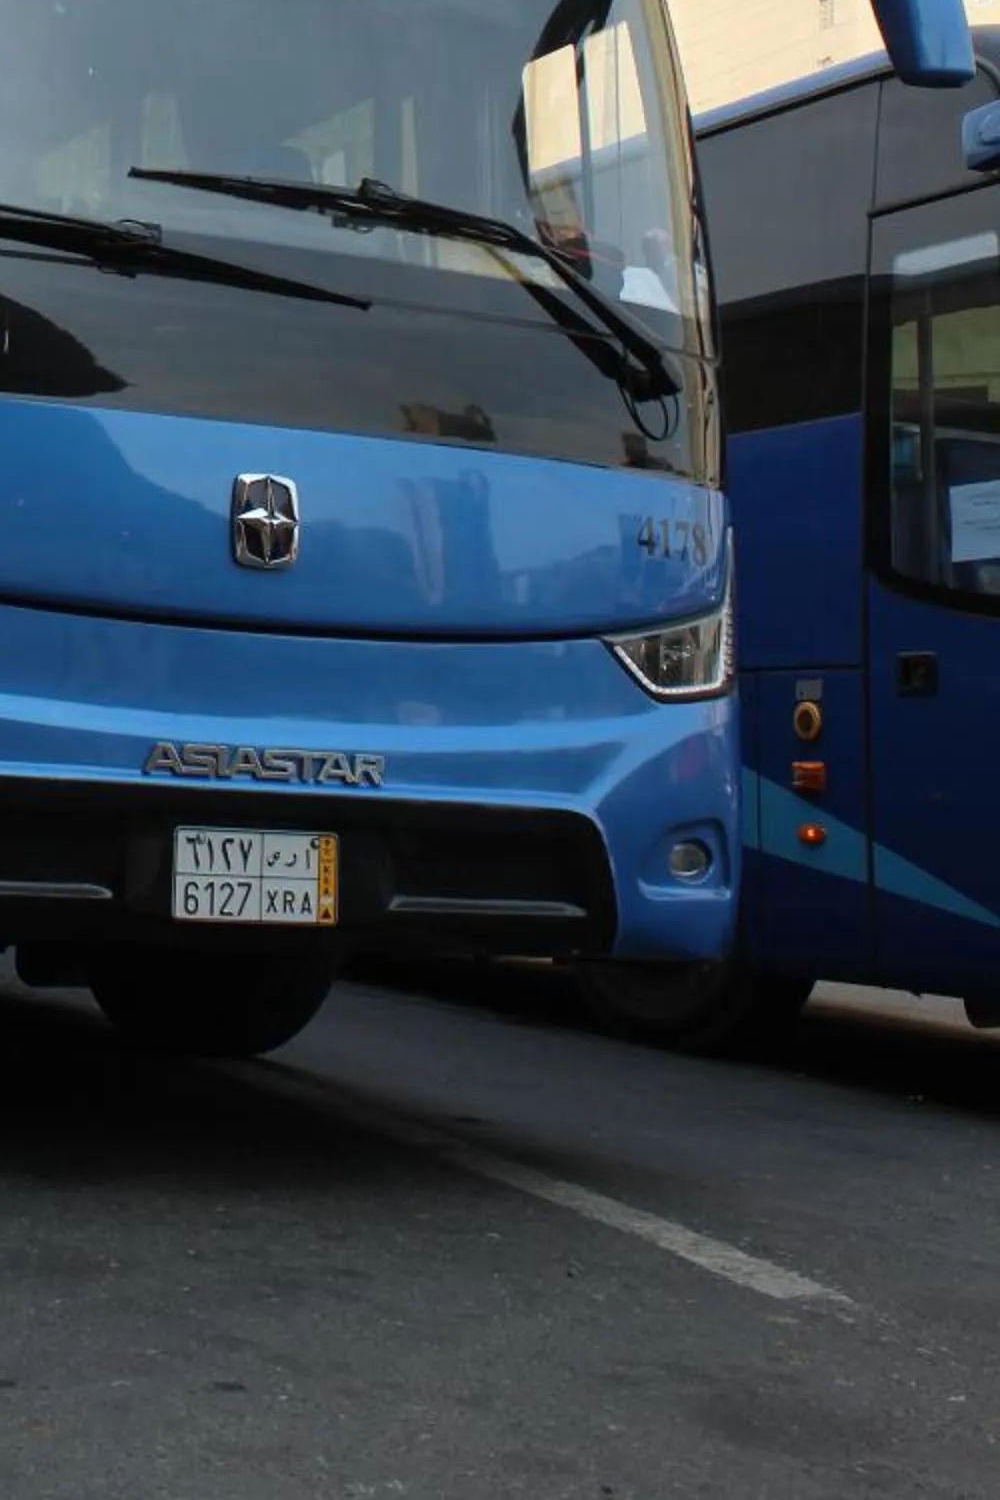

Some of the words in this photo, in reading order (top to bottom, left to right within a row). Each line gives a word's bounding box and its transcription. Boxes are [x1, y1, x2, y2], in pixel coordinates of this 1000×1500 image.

[637, 515, 706, 567] 4178
[142, 741, 385, 788] ASIASTAR
[184, 835, 253, 874] ٦١٢٧
[183, 880, 253, 917] 6127
[265, 888, 313, 915] XRA
